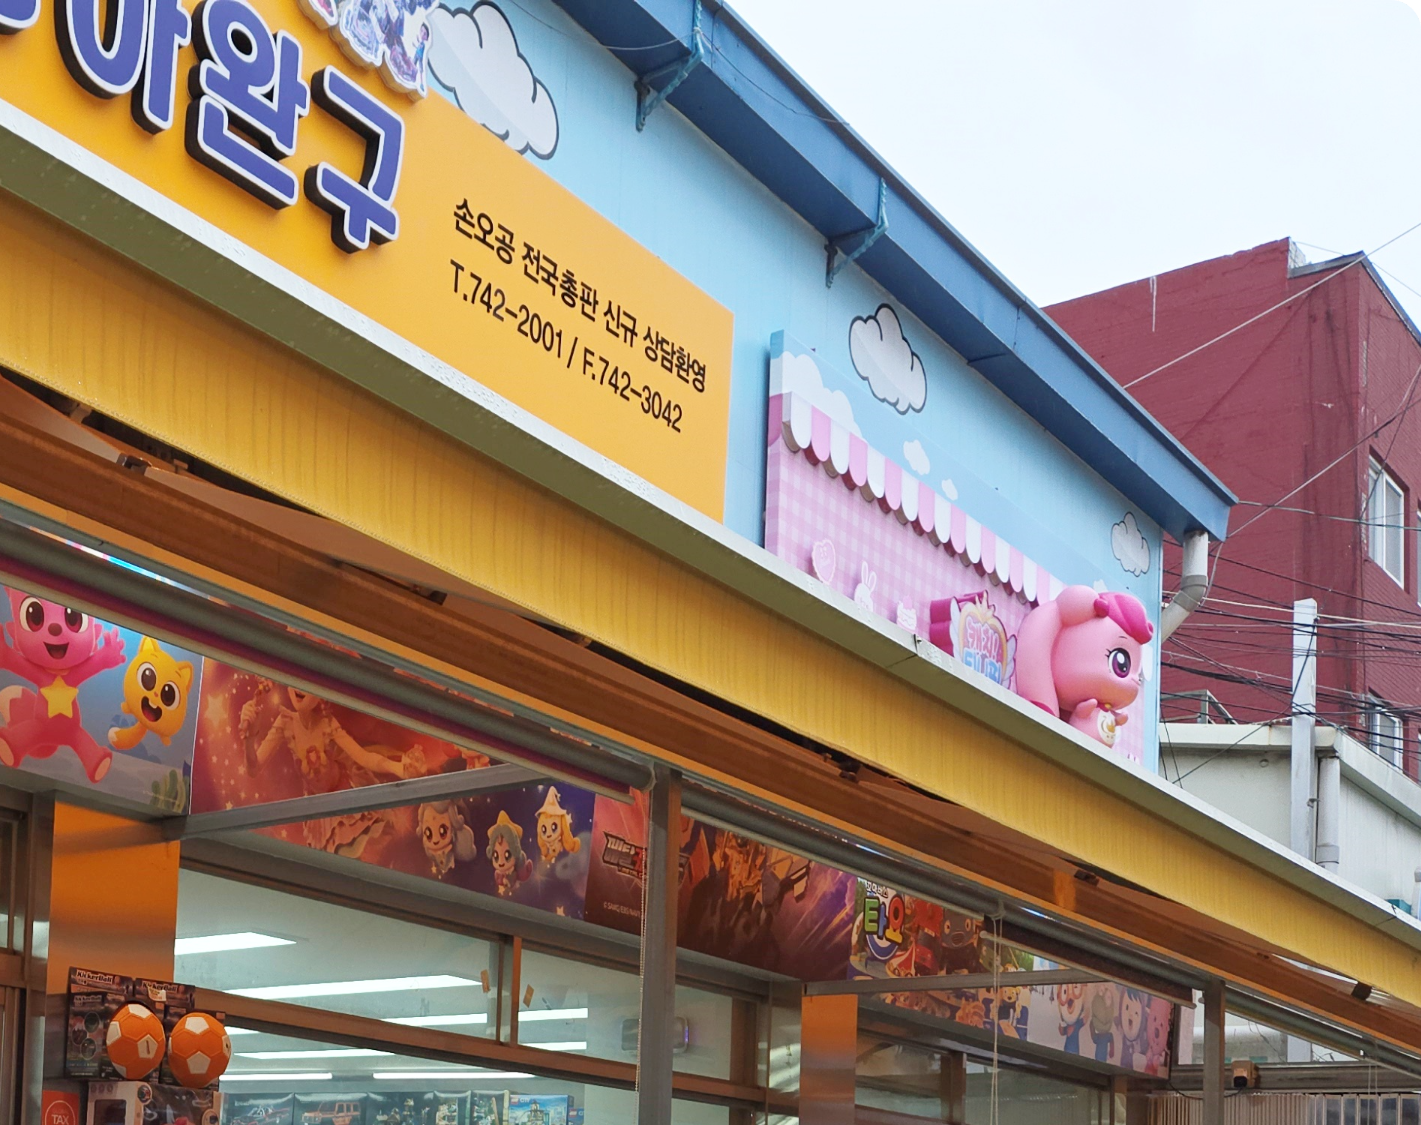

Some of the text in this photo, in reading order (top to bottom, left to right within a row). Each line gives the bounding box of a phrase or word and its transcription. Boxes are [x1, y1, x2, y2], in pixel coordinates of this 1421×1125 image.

[450, 259, 683, 433] T.742-2001 / F.742-3042
[453, 198, 706, 393] 손오공 전국총판 신규 상담환영
[863, 893, 905, 944] 타요
[51, 1114, 70, 1125] TAX
